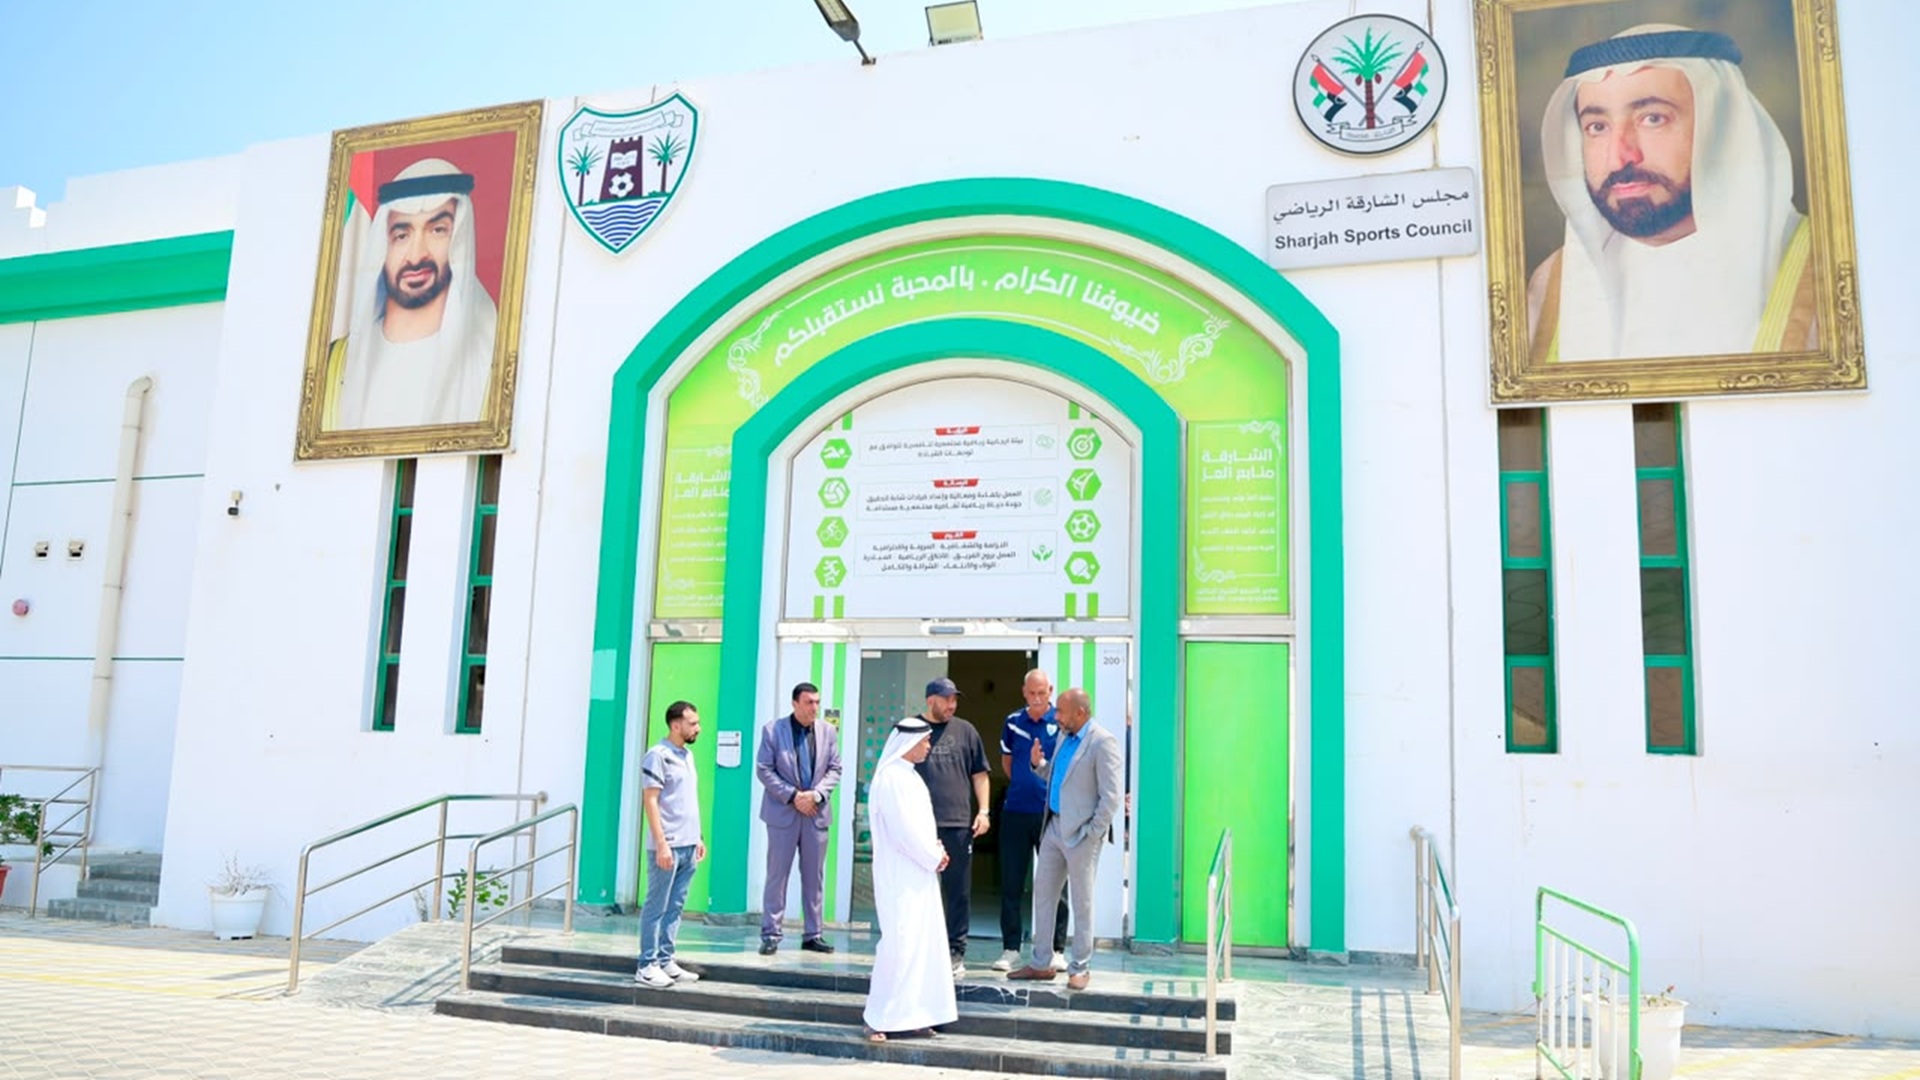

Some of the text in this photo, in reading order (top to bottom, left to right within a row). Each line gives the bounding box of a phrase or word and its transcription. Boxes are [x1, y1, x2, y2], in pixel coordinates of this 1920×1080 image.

[1273, 189, 1470, 225] مجلس الشارقة الرياضي
[1275, 219, 1472, 250] Sharjah Sports Council
[891, 265, 974, 298] بالمحبة
[994, 266, 1078, 298] الكرام
[1081, 280, 1162, 336] ضيوفنا
[773, 283, 885, 368] نستقبلكم
[1201, 448, 1272, 464] الشارقة
[1202, 465, 1275, 482] منابع العز
